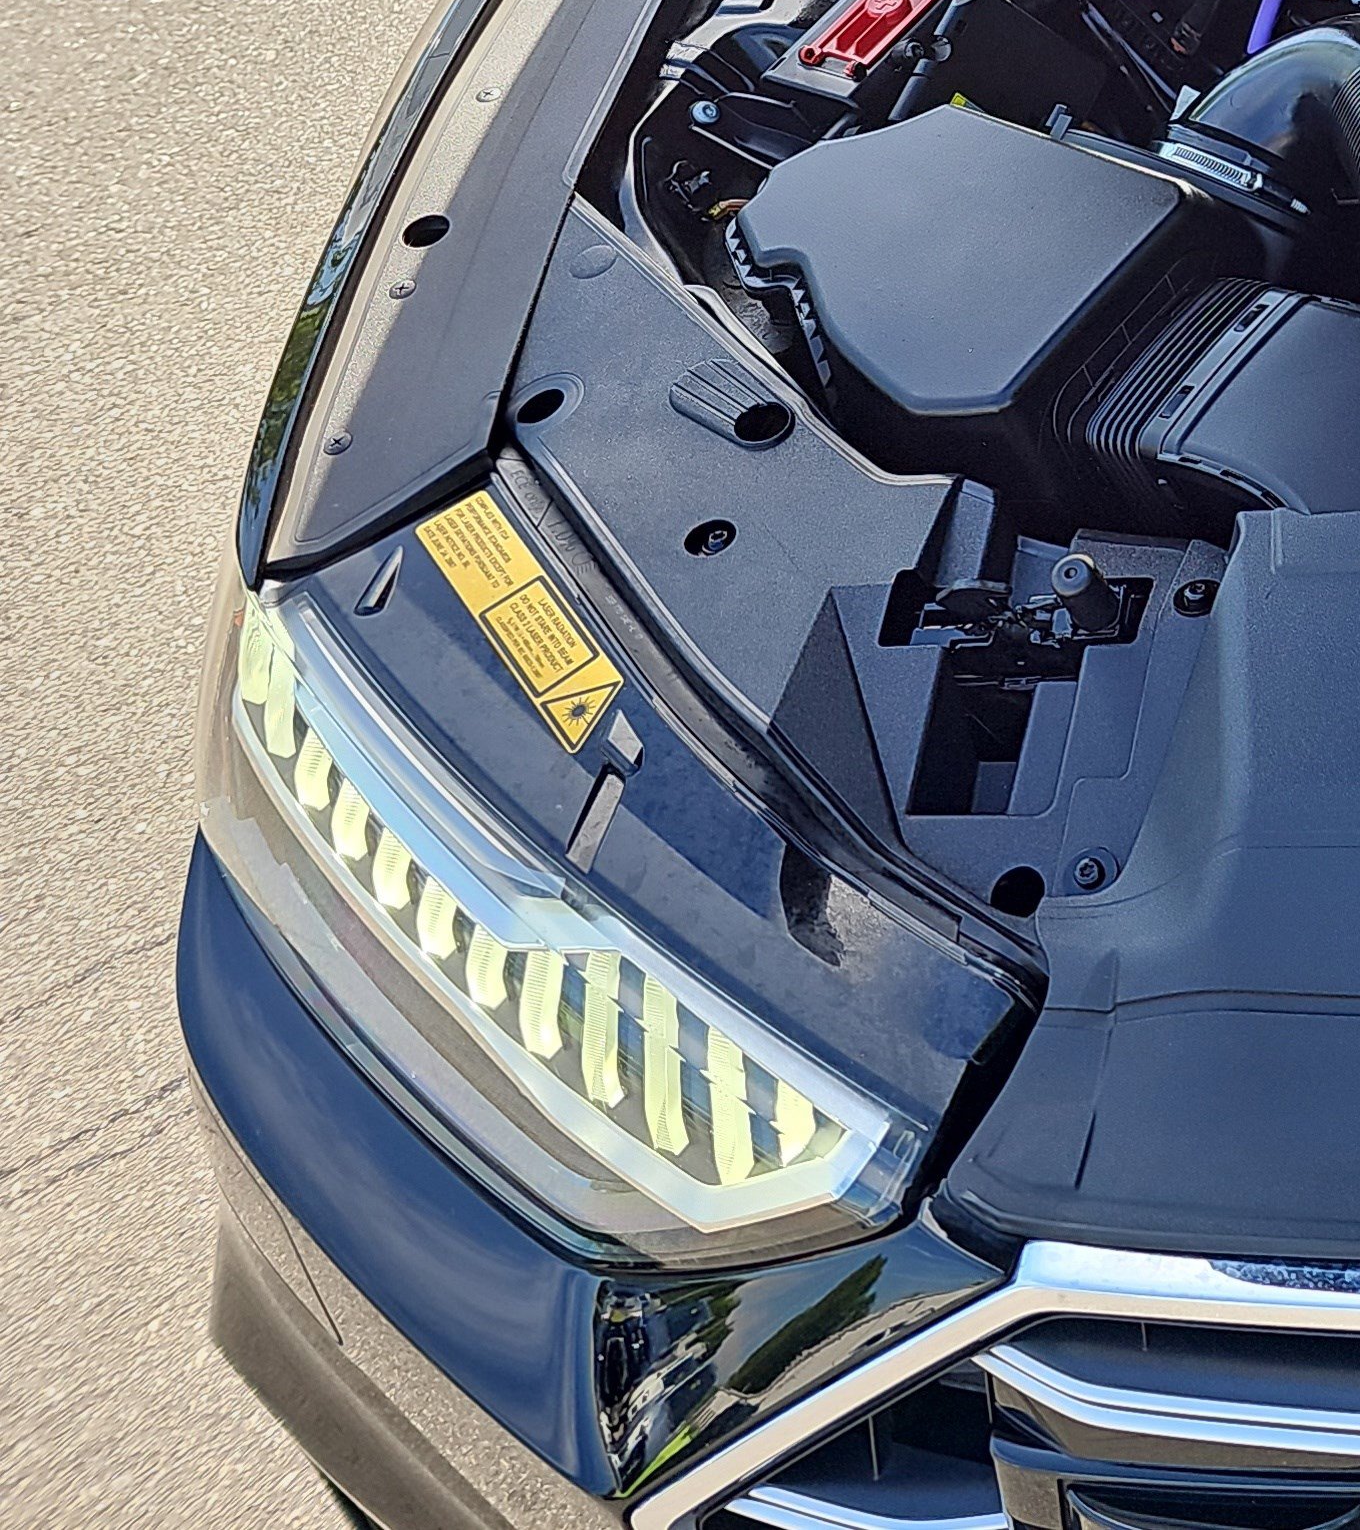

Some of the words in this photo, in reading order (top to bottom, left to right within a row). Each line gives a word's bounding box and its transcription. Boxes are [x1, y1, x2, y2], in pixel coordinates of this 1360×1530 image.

[509, 601, 526, 622] CLASS
[526, 625, 543, 645] LASER
[539, 643, 563, 673] PRODUCT
[519, 593, 530, 605] DO
[525, 602, 539, 616] NOT
[535, 614, 551, 635] STARE
[548, 633, 561, 648] INTO
[557, 647, 573, 665] BEAM
[538, 598, 555, 618] LASER
[551, 616, 576, 648] RADIATION
